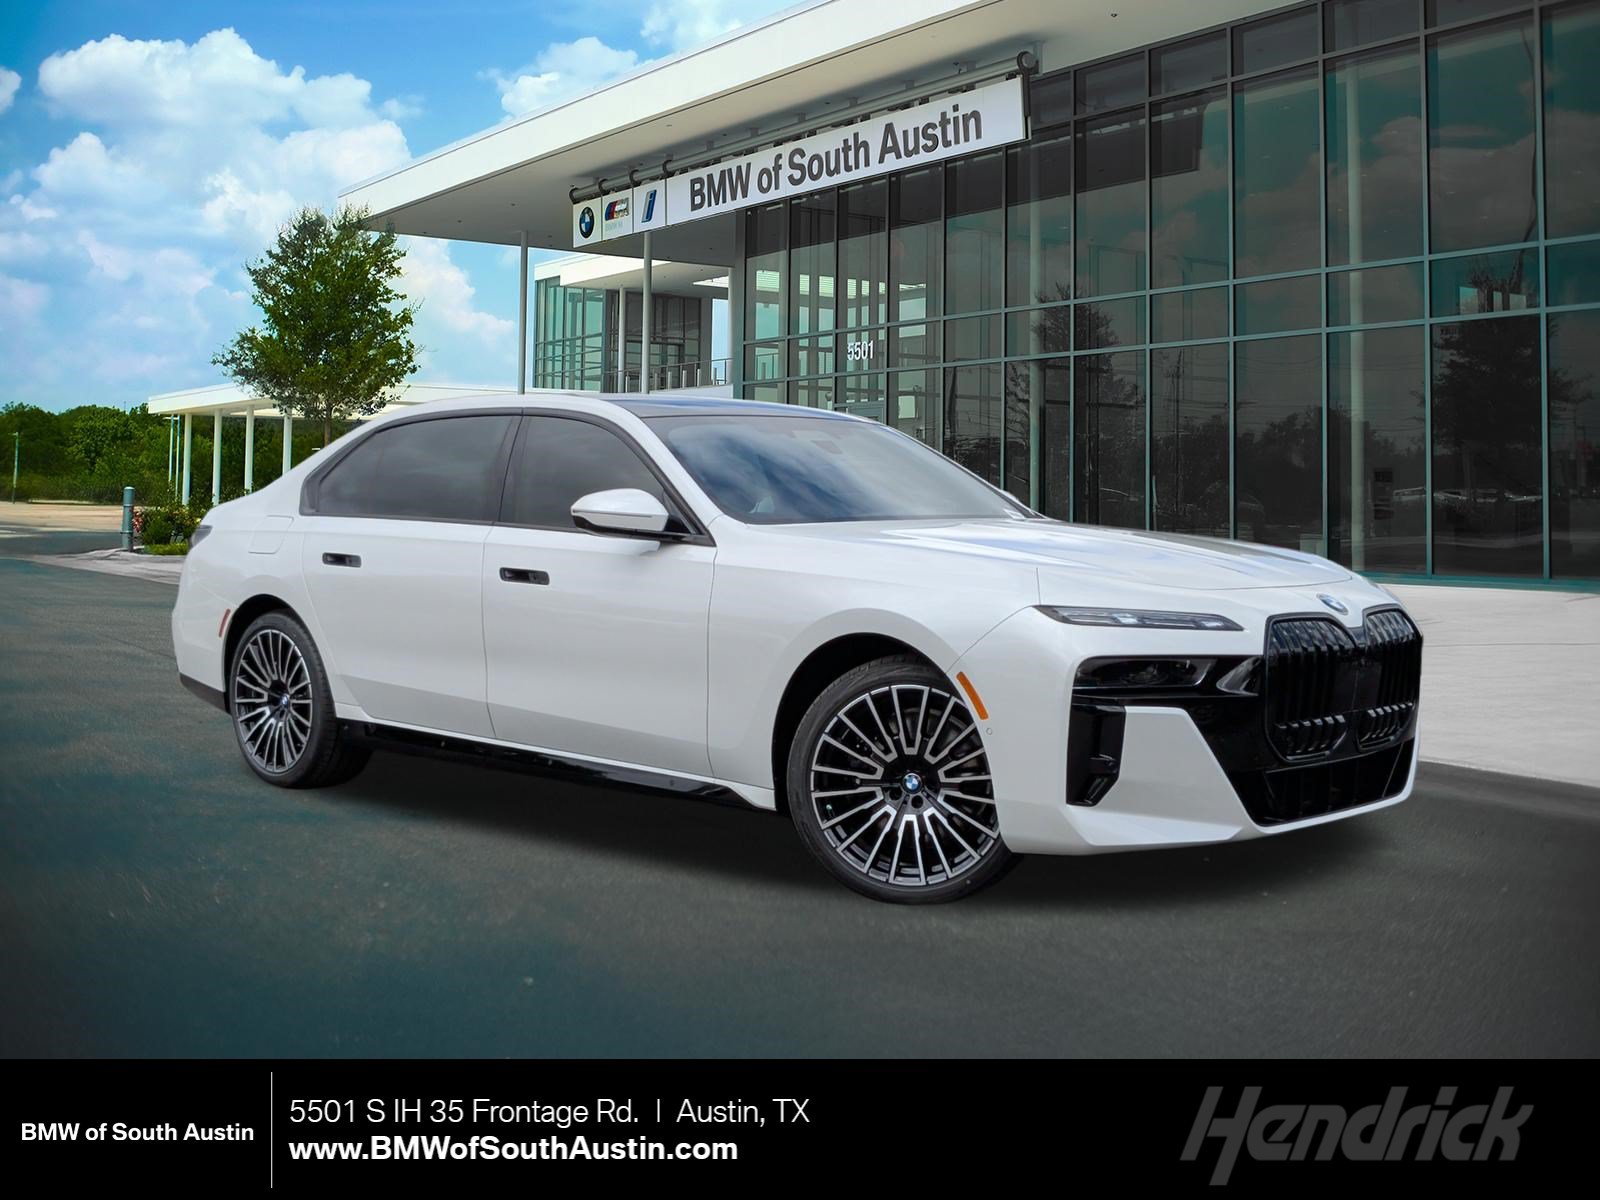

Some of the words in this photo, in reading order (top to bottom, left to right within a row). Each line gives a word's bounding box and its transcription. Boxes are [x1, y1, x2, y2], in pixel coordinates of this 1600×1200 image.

[690, 162, 751, 212] BMW
[757, 153, 783, 194] of
[787, 131, 871, 187] South
[878, 103, 983, 165] Austin
[847, 340, 874, 361] 5501
